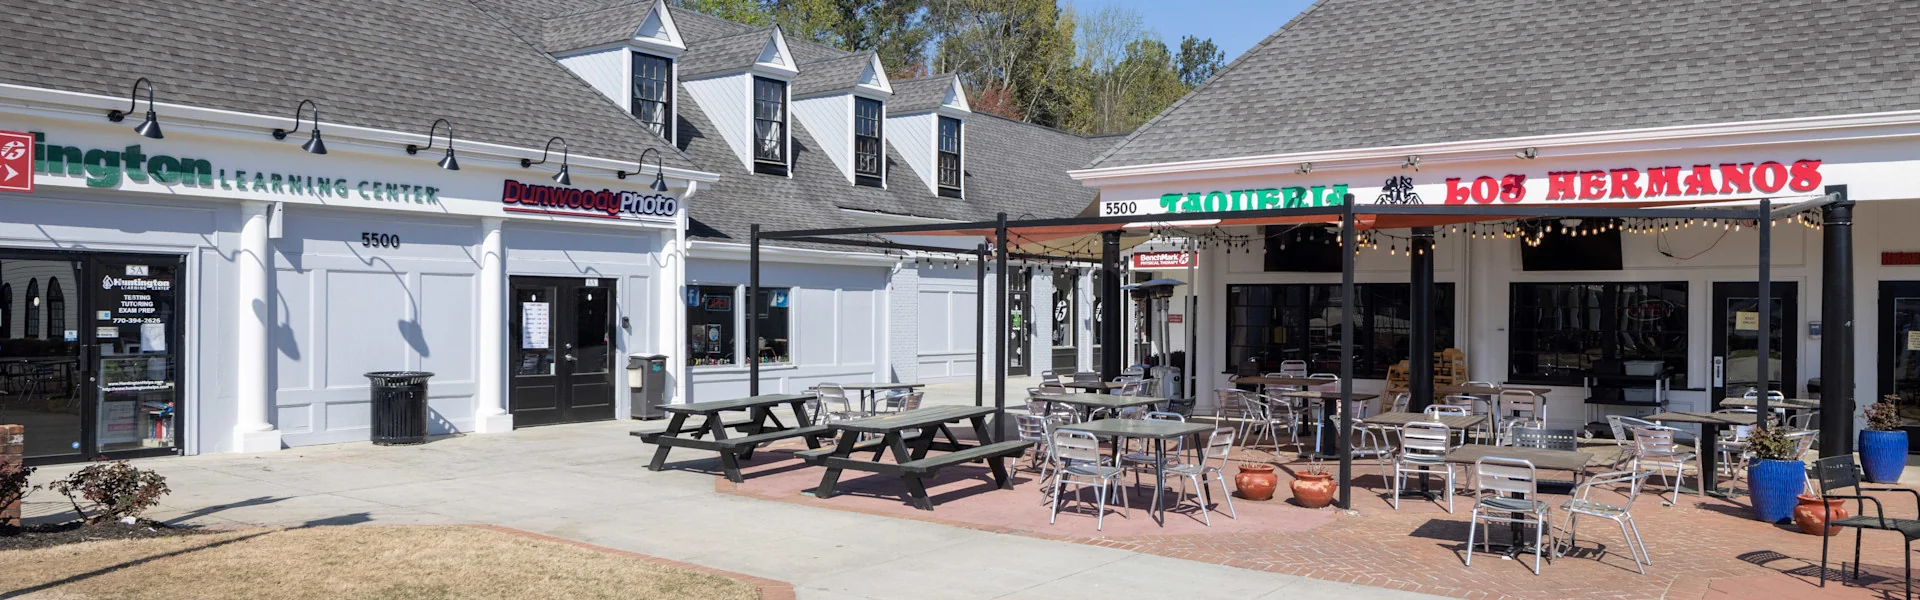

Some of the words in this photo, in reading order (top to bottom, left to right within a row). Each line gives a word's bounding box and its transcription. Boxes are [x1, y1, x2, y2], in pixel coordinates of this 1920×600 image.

[220, 169, 348, 197] LEARNING
[357, 181, 437, 204] CENTER
[1445, 174, 1527, 205] LOS
[1545, 159, 1823, 200] HERMANOS
[1106, 201, 1137, 215] 5500
[361, 232, 400, 249] 5500
[1140, 253, 1178, 261] BenchMark
[130, 266, 144, 275] 5A
[113, 278, 170, 288] Huntington
